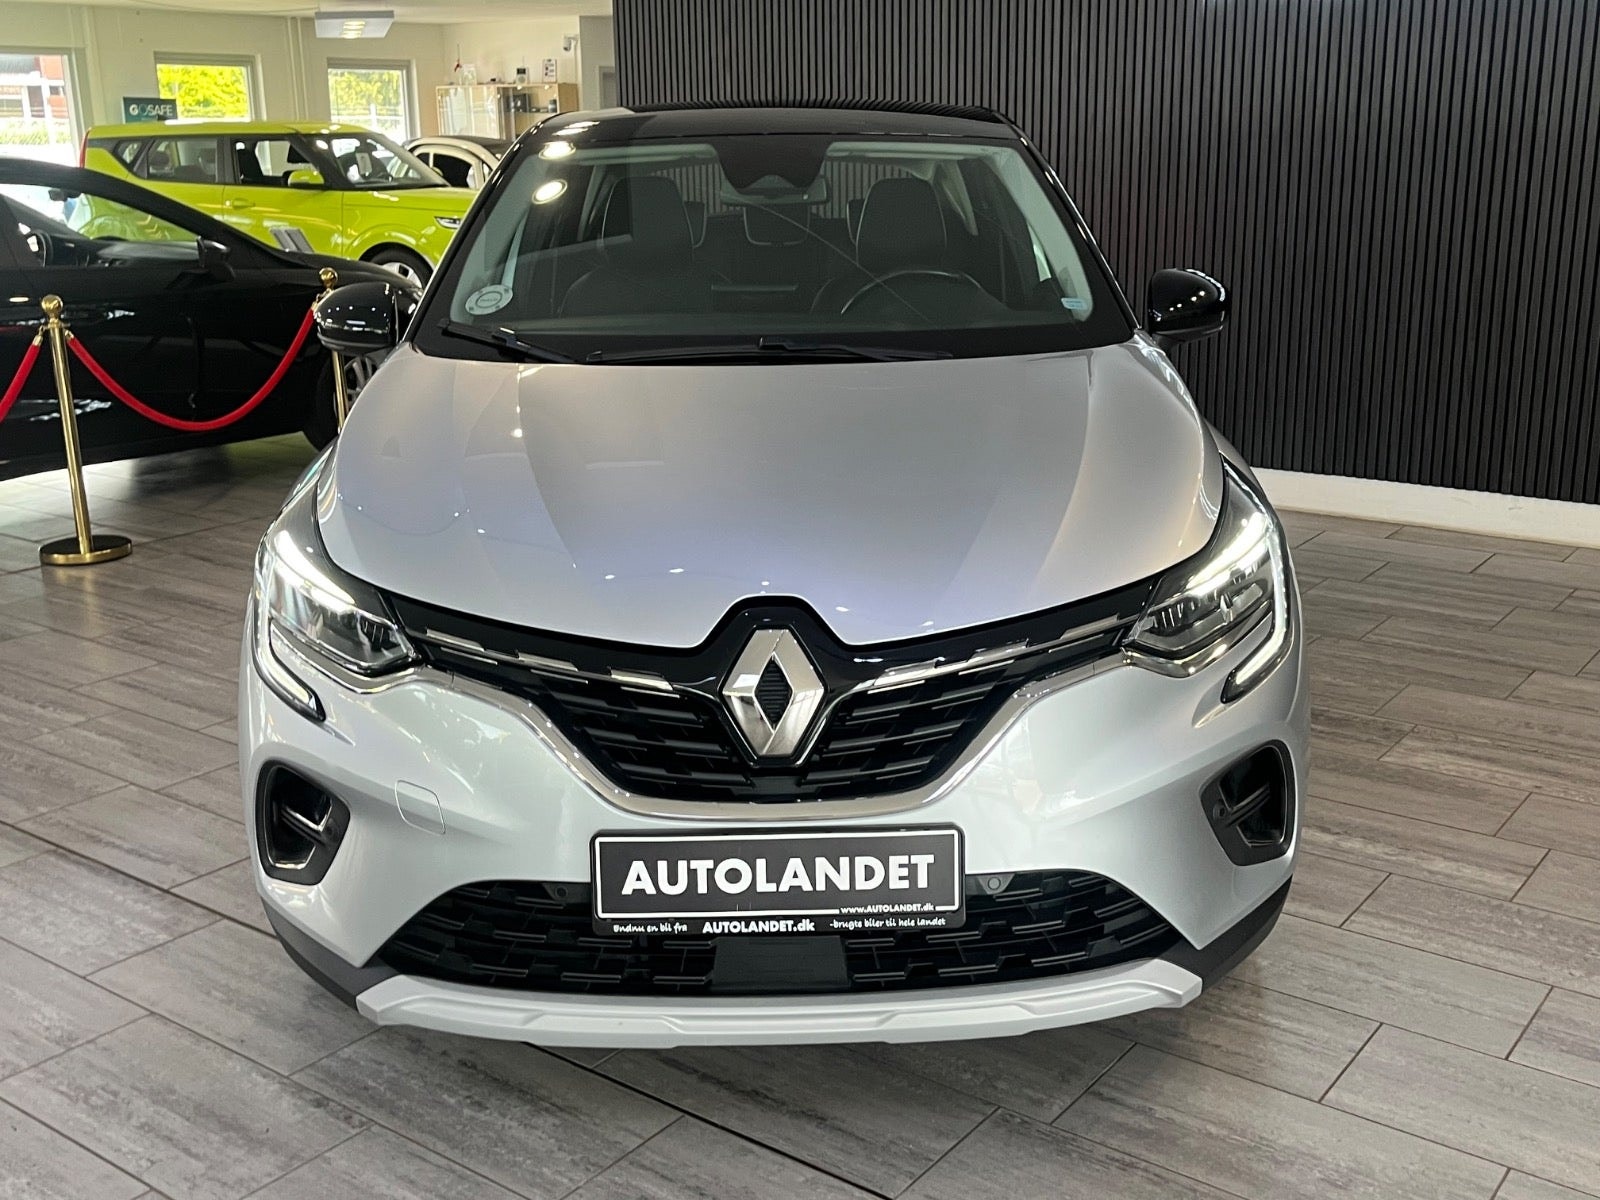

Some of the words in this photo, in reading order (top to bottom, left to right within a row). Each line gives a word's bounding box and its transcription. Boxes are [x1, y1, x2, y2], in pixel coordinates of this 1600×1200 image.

[621, 854, 935, 896] AUTOLANDET
[840, 903, 934, 914] www.AUTOLANDET.dk
[646, 924, 658, 933] en
[659, 922, 672, 932] bil
[673, 922, 688, 934] fra
[702, 919, 815, 934] AUTOLANDET.dk
[864, 918, 885, 928] biler
[885, 917, 897, 927] til
[898, 917, 915, 927] hele
[916, 917, 946, 927] landet
